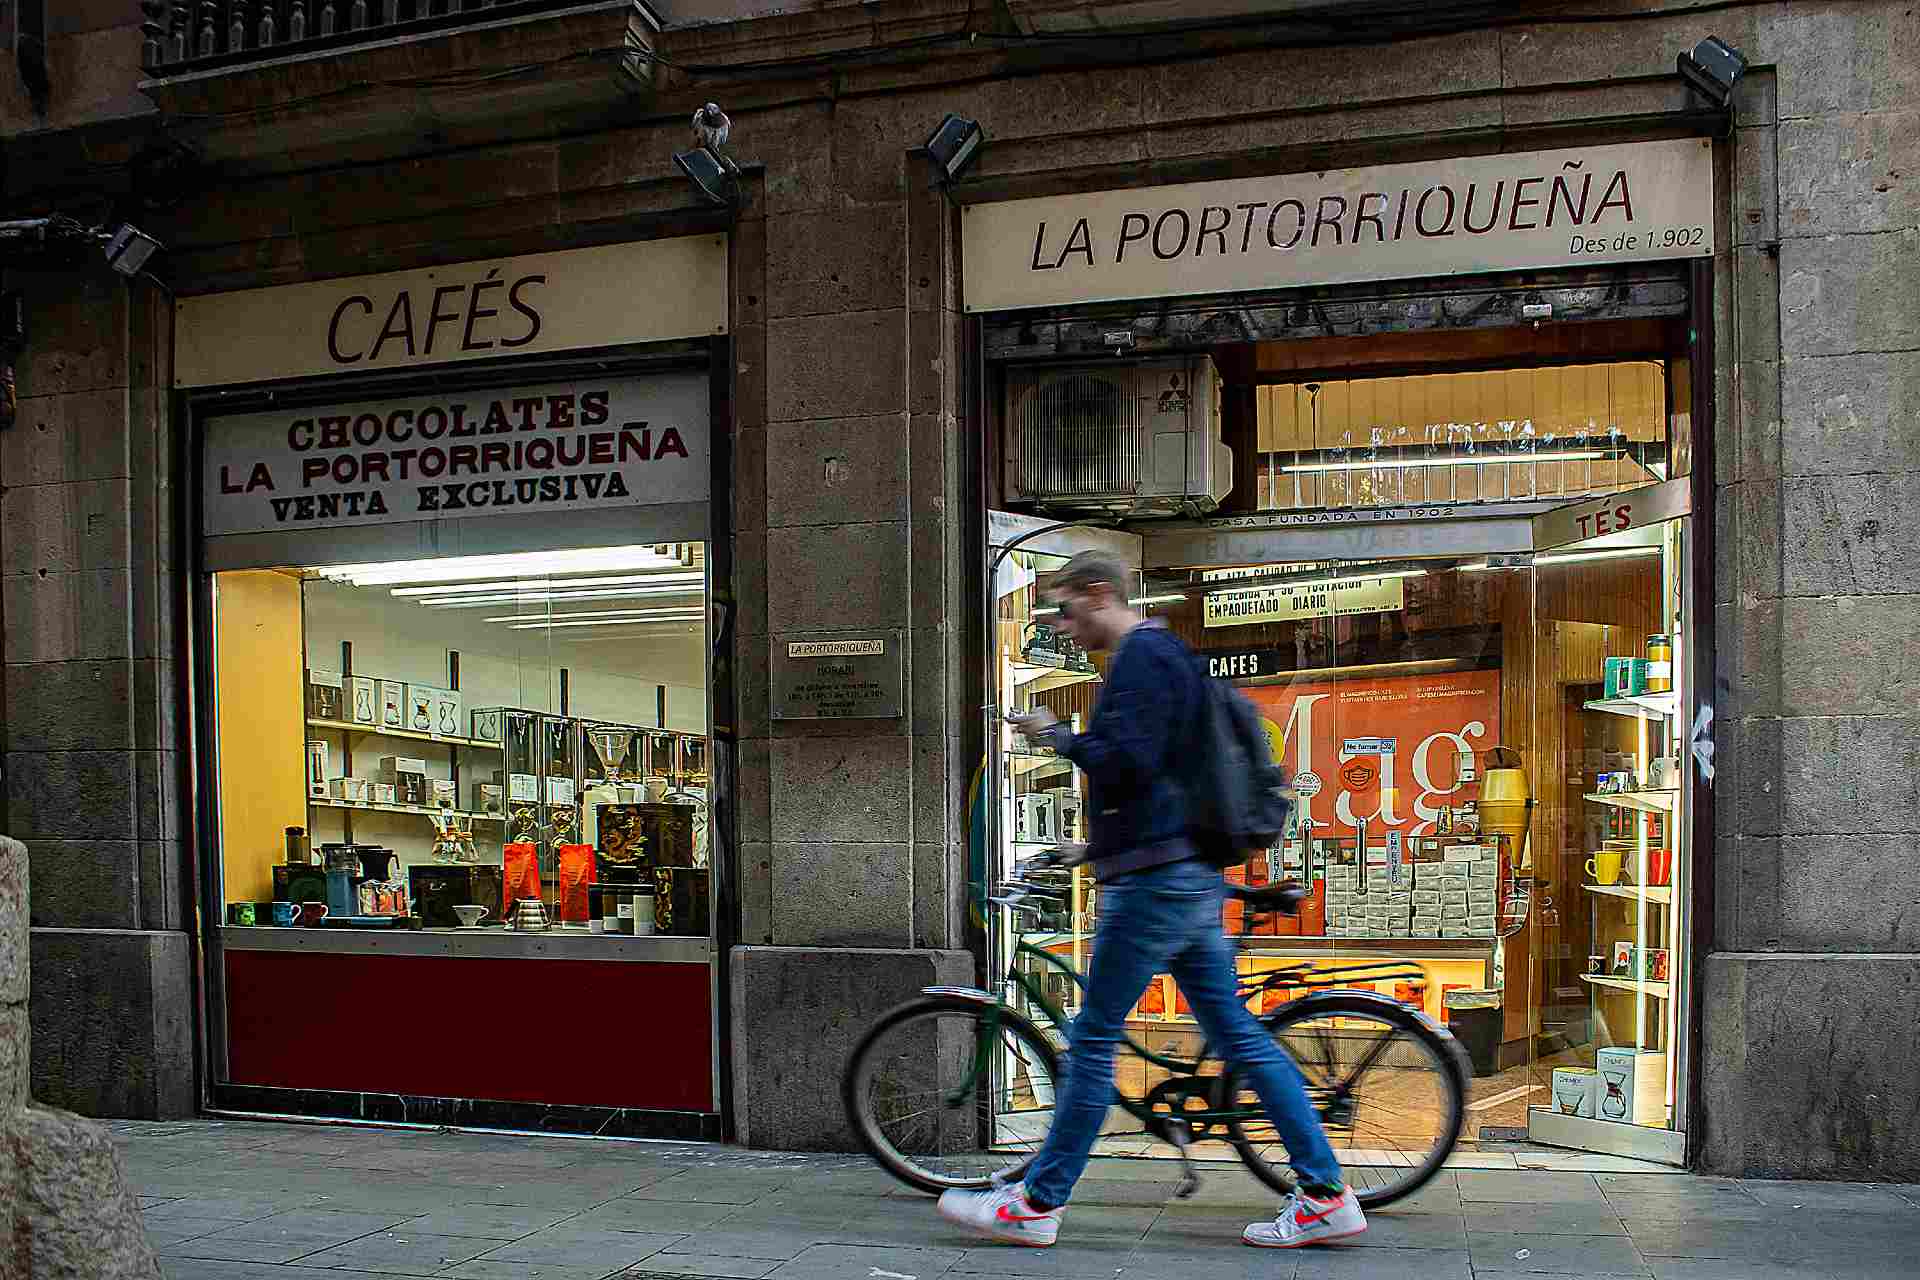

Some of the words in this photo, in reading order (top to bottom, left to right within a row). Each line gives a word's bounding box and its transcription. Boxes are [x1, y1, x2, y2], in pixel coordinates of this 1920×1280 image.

[1031, 217, 1094, 270] LA
[1115, 160, 1634, 263] PORTORRIQUEÑA
[1569, 235, 1607, 254] Des
[1613, 232, 1637, 251] de
[1647, 228, 1704, 250] 1.902
[328, 268, 546, 363] CAFÉS
[287, 390, 610, 452] CHOCOLATES
[220, 462, 275, 494] LA
[301, 421, 689, 487] PORTORRIQUEÑA
[270, 490, 388, 520] VENTA
[416, 471, 629, 512] EXCLUSIVA
[1209, 517, 1257, 528] CASA
[1268, 512, 1359, 525] FUNDADA
[1373, 511, 1397, 520] EN
[1408, 507, 1455, 518] 1902
[1576, 498, 1632, 538] TÉS
[1208, 598, 1279, 618] EMPAQUETADO
[1293, 594, 1326, 611] DIARIO
[1209, 654, 1258, 677] CAFES
